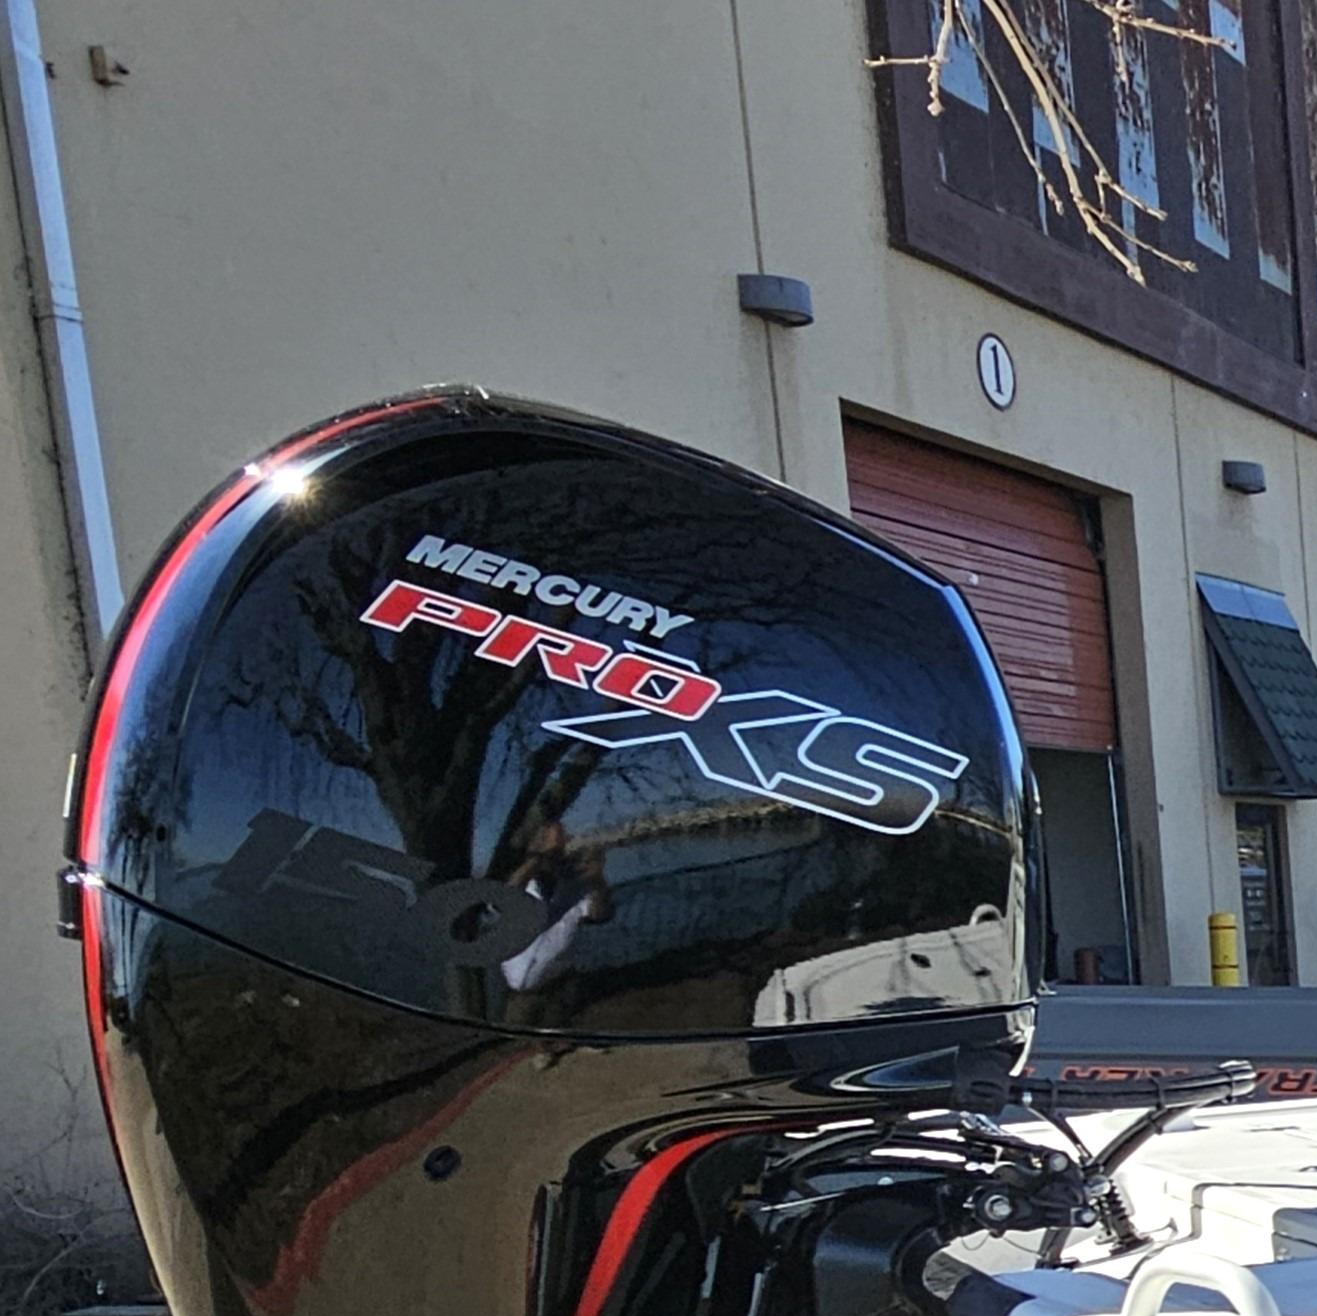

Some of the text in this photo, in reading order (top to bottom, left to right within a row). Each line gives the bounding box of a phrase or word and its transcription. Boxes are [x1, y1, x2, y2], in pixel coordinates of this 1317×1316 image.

[989, 343, 1004, 396] 1
[405, 534, 696, 640] MERCURY
[359, 579, 722, 722] PRO
[540, 638, 971, 836] XS
